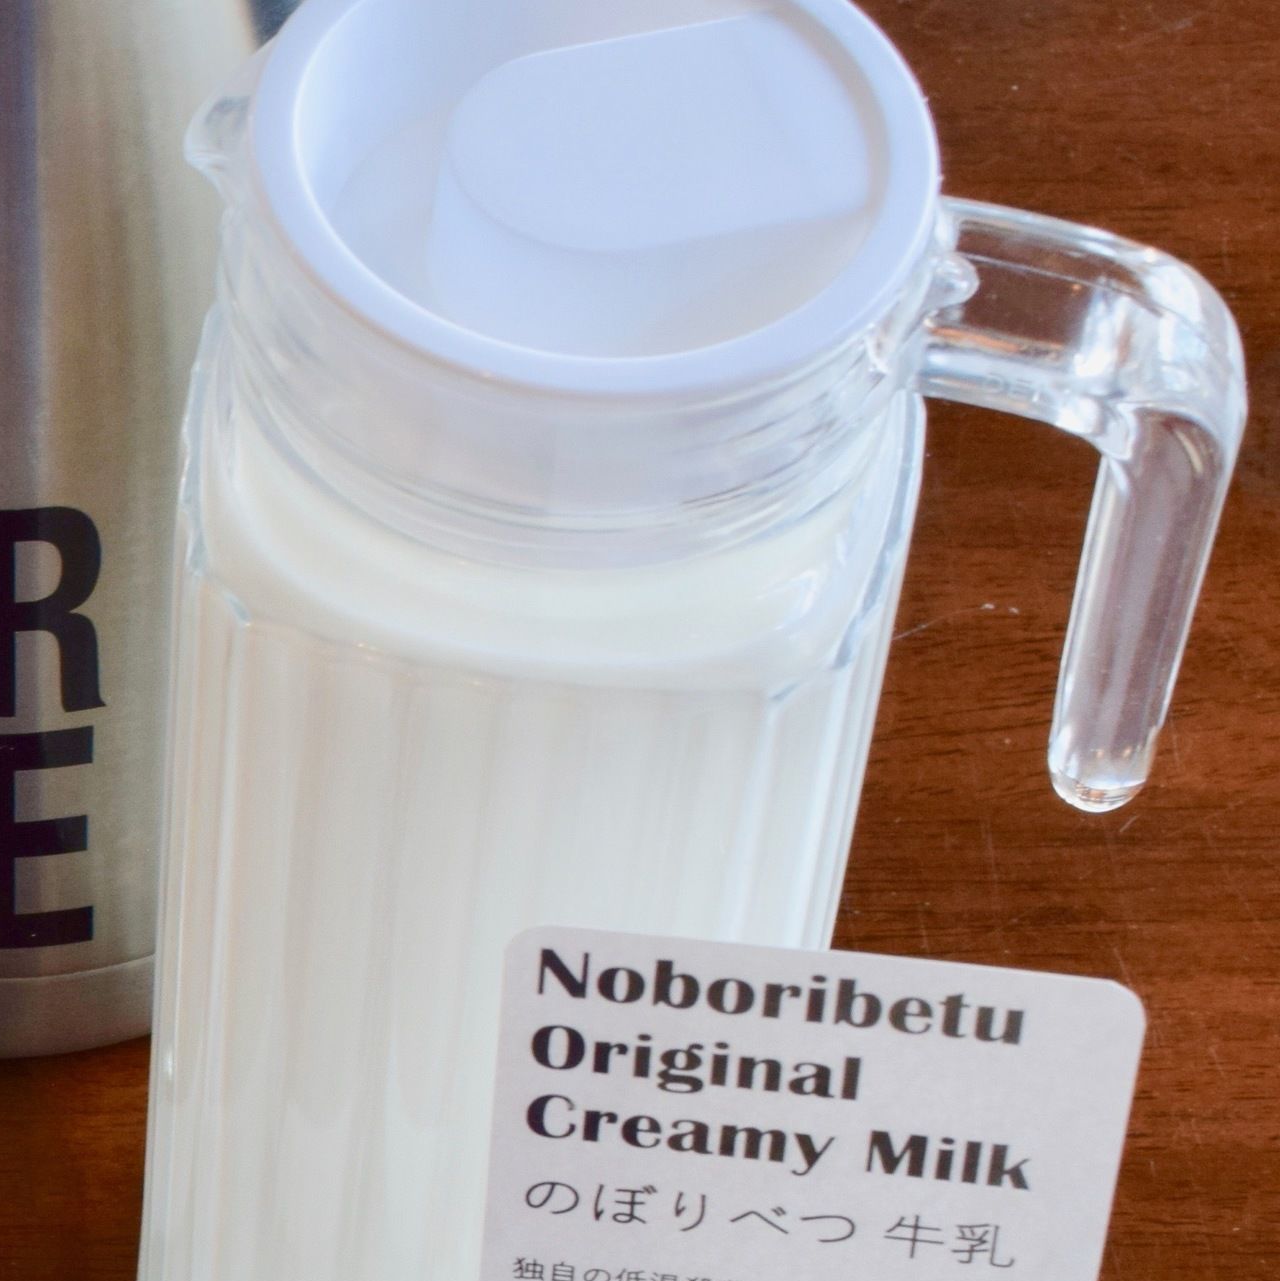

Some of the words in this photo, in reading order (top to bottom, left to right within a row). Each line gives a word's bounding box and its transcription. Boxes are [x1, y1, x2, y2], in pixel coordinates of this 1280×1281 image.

[537, 948, 1025, 1045] Noboribetu
[531, 1025, 863, 1100] Original
[526, 1095, 835, 1176] Creamy
[866, 1131, 1031, 1190] Milk
